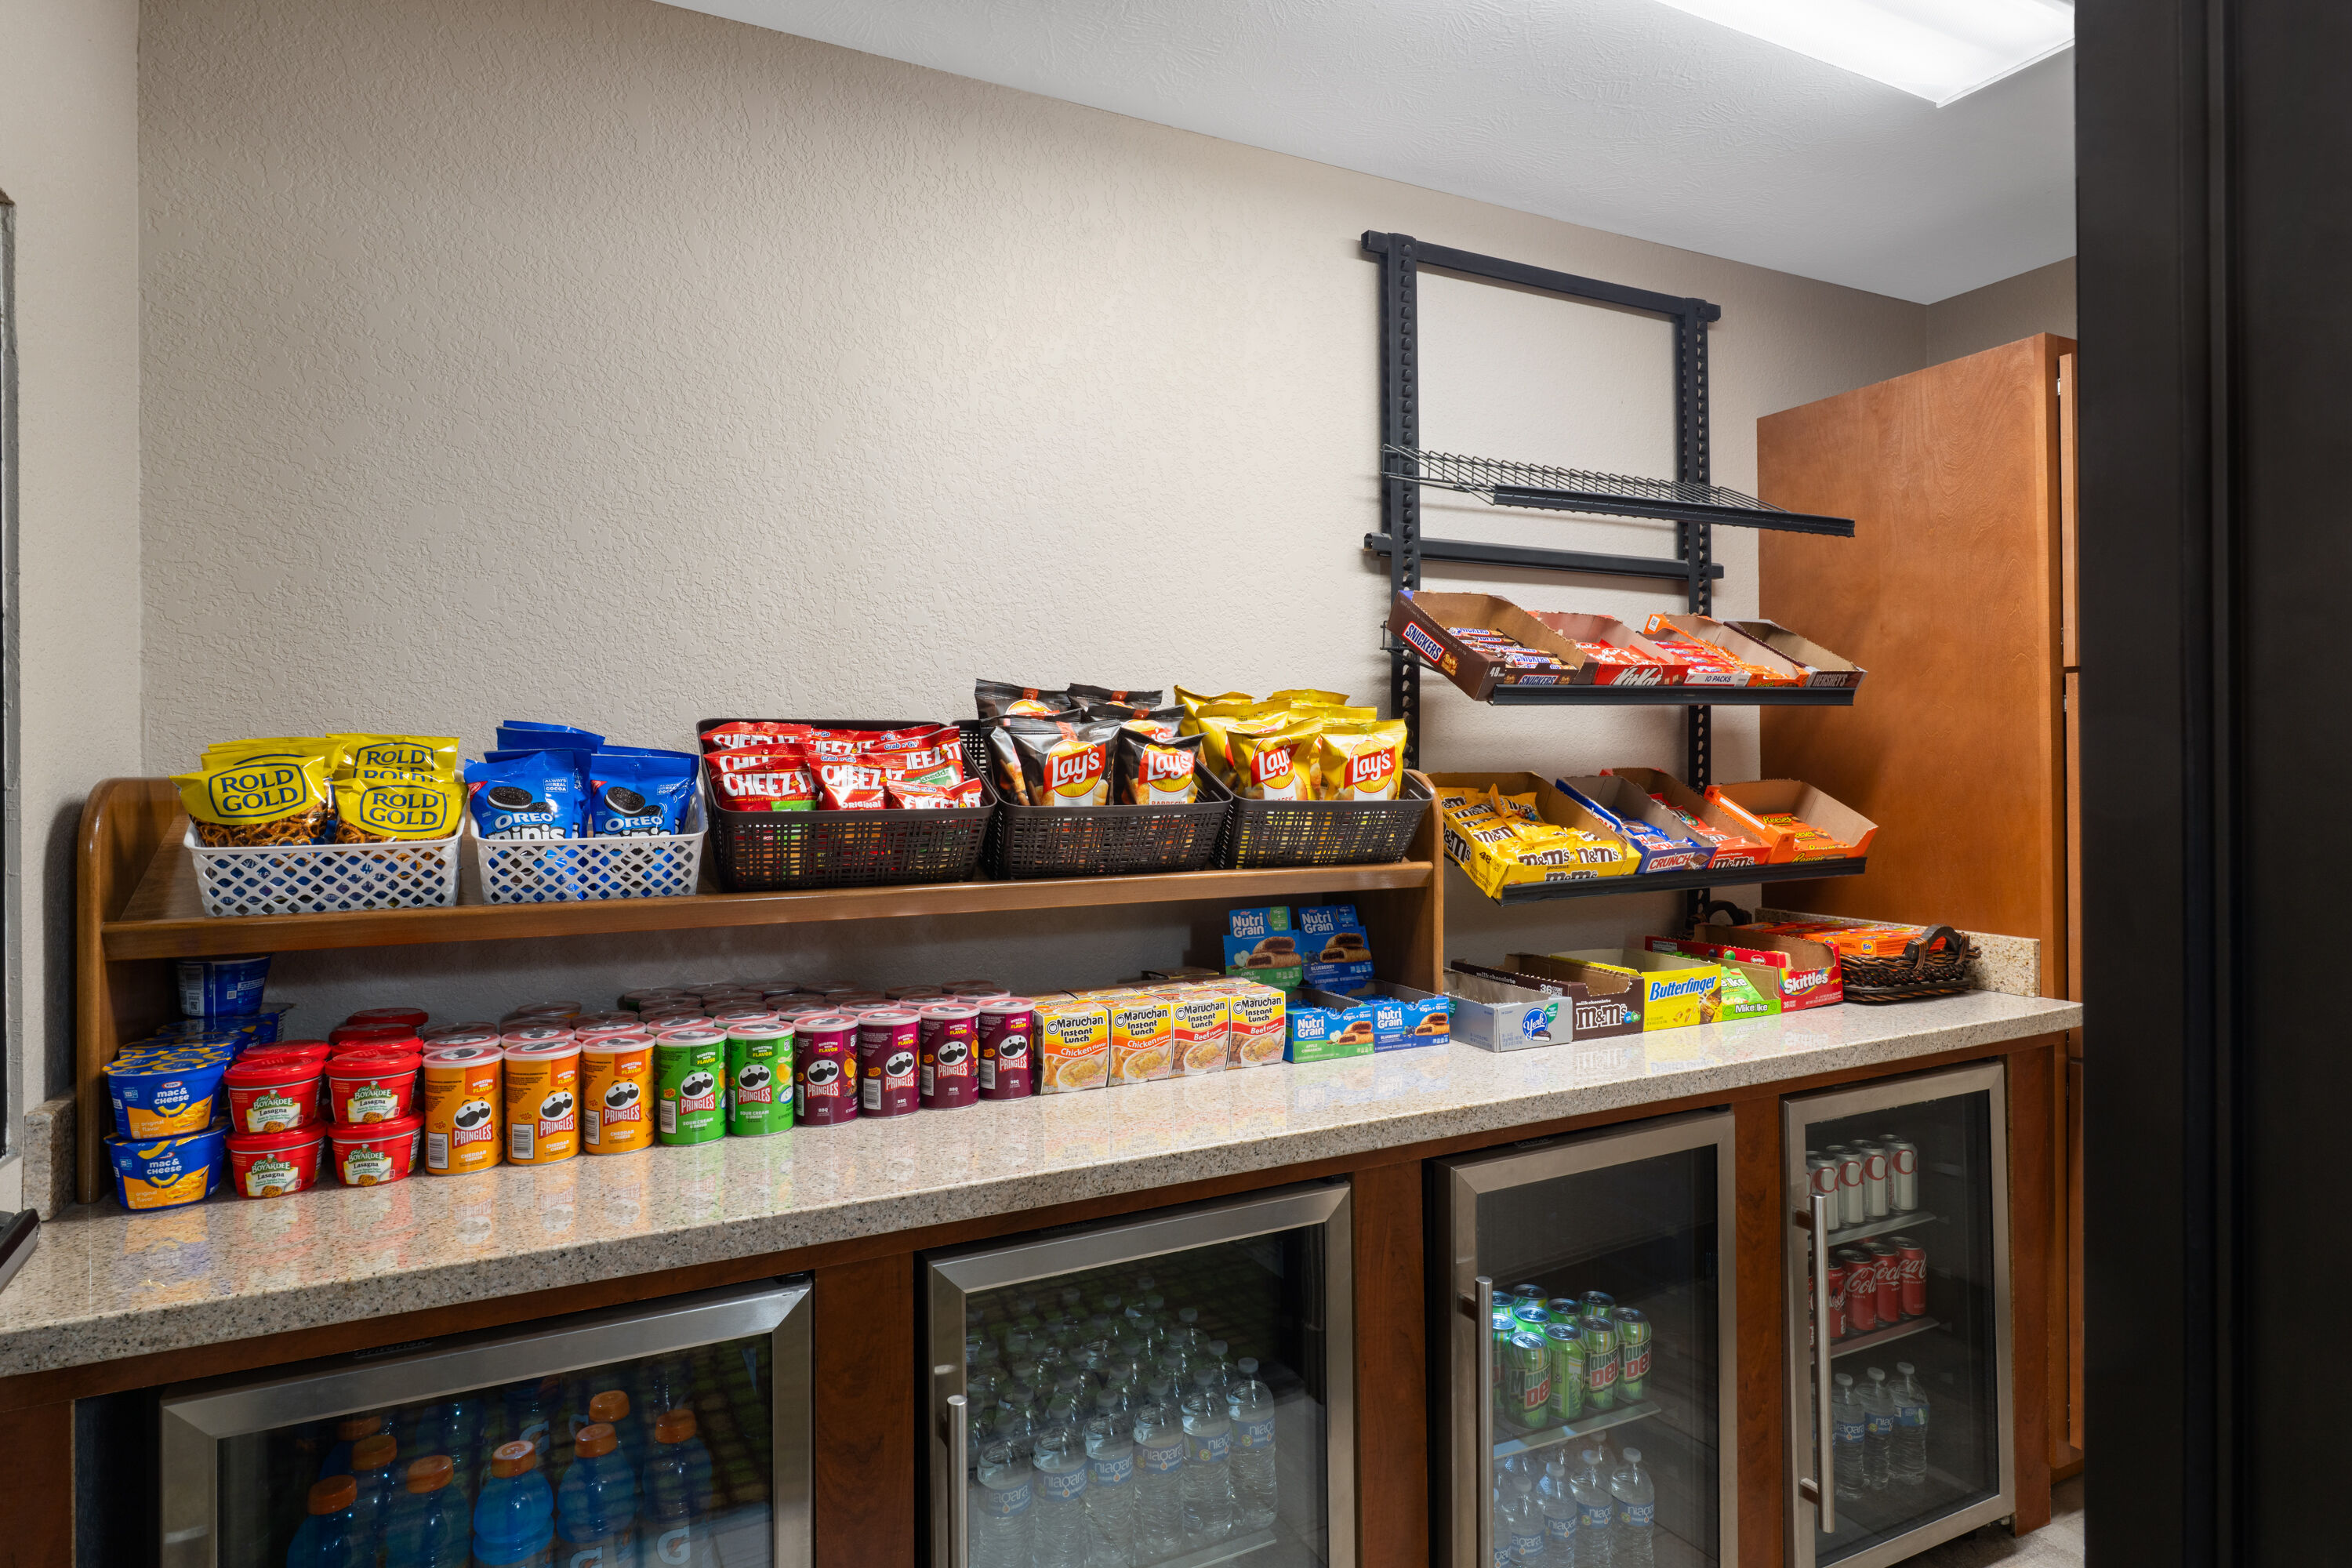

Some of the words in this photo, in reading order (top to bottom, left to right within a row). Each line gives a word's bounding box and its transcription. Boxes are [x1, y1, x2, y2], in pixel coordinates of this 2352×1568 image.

[1405, 624, 1443, 660] SNICKERS
[1515, 654, 1550, 663] SNICKERS
[1490, 667, 1501, 677] 48
[1704, 674, 1711, 683] 10
[1519, 675, 1557, 685] SNICKERS
[366, 750, 426, 766] ROLD
[1052, 748, 1102, 788] Lay's
[1148, 751, 1194, 781] Lay's
[1352, 750, 1393, 783] Lay's
[220, 769, 294, 793] ROLD
[223, 786, 298, 811] GOLD
[372, 793, 439, 810] ROLD
[369, 808, 438, 825] GOLD
[495, 812, 554, 829] OREO
[604, 816, 662, 831] OREO
[1763, 815, 1791, 824] Reese's
[1479, 851, 1491, 864] 48
[1650, 854, 1692, 870] CRUNCH
[1713, 856, 1754, 869] m&m's
[1232, 912, 1263, 927] Nutri
[1301, 910, 1332, 926] Nutri
[1233, 925, 1265, 938] Grain
[1305, 922, 1334, 935] Grain
[1540, 984, 1552, 993] 36
[1649, 975, 1717, 1002] Butterfinger
[1784, 972, 1828, 994] Skittles
[1185, 1001, 1225, 1014] Maruchan
[1242, 996, 1282, 1008] Maruchan
[1735, 1004, 1755, 1013] Mike
[1757, 1003, 1768, 1011] Ike
[1124, 1008, 1168, 1021] Maruchan
[1188, 1012, 1216, 1022] Instant
[1245, 1007, 1272, 1017] Instant
[1248, 1013, 1270, 1022] Lunch
[1377, 1007, 1402, 1021] Nutri
[1577, 1004, 1627, 1029] m&m's
[1058, 1015, 1104, 1029] Maruchan
[1127, 1019, 1158, 1029] Instant
[1191, 1019, 1214, 1029] Lunch
[1250, 1025, 1267, 1035] Beef
[1266, 1022, 1279, 1031] Flavor
[1298, 1015, 1324, 1030] Nutri
[1378, 1018, 1403, 1029] Grain
[1523, 1013, 1546, 1041] York
[1060, 1027, 1093, 1037] Instant
[1131, 1026, 1155, 1036] Lunch
[1194, 1031, 1210, 1041] Beef
[1210, 1027, 1222, 1036] Flavor
[1298, 1027, 1325, 1038] Grain
[1064, 1033, 1090, 1044] Lunch
[1127, 1036, 1157, 1048] Chicken
[1156, 1033, 1171, 1042] Flavor
[1061, 1044, 1092, 1056] Chicken
[1092, 1041, 1107, 1051] Flavor
[938, 1063, 967, 1077] PRINGLES
[1000, 1056, 1027, 1071] PRINGLES
[558, 1076, 575, 1085] FLAVOR
[886, 1075, 914, 1091] PRINGLES
[157, 1089, 179, 1098] mac
[354, 1088, 392, 1101] BOYARDEE
[739, 1087, 771, 1104] PRINGLES
[808, 1083, 839, 1098] PRINGLES
[253, 1098, 293, 1111] BOYARDEE
[359, 1098, 386, 1107] Lasagna
[681, 1094, 715, 1112] PRINGLES
[259, 1107, 288, 1116] Lasagna
[604, 1105, 640, 1123] PRINGLES
[540, 1120, 574, 1137] PRINGLES
[454, 1126, 492, 1146] PRINGLES
[348, 1152, 384, 1163] BOYARDEE
[252, 1162, 291, 1174] BOYARDEE
[257, 1171, 285, 1181] Lasagna
[1044, 1468, 1087, 1491] niagara
[985, 1485, 1029, 1507] niagara
[657, 1526, 690, 1566] G
